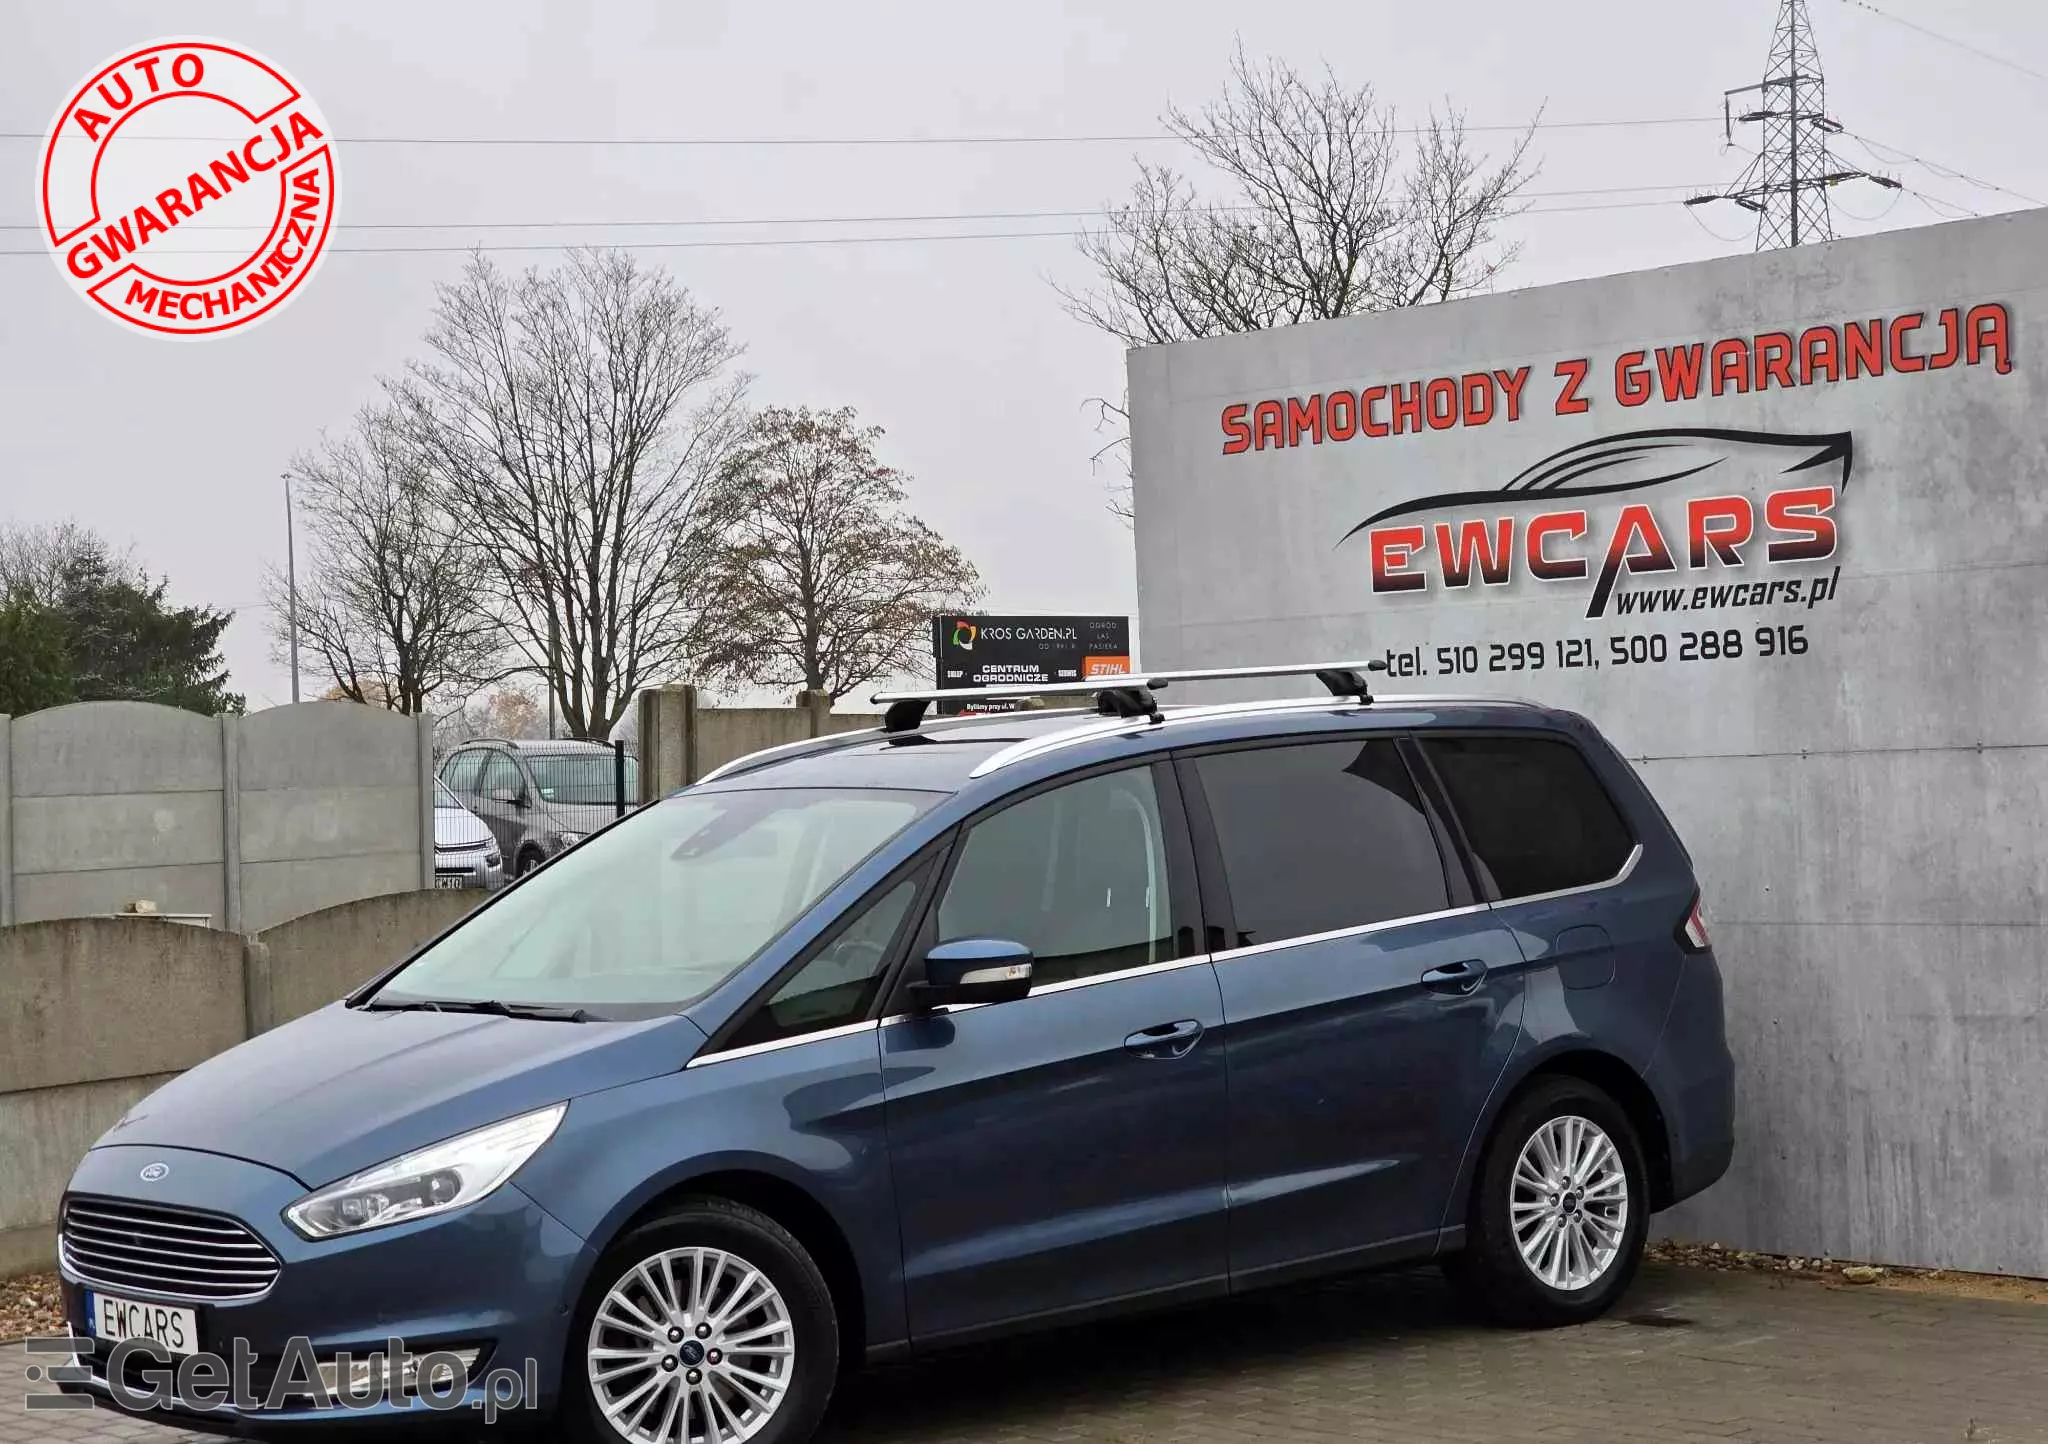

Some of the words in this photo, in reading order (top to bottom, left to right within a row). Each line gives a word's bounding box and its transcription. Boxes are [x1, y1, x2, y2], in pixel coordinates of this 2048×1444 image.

[1222, 365, 1531, 456] SAMOCHODY
[1554, 358, 1589, 416] Z
[1615, 302, 2013, 407] GWARANCJĄ
[1369, 485, 1841, 619] EWCARS
[1616, 566, 1840, 616] www.ewcars.pl
[980, 627, 1012, 640] KROS
[1016, 627, 1078, 640] GARDEN.PL
[1386, 647, 1427, 679] tel.
[1437, 646, 1478, 676] 510
[1489, 642, 1545, 672] 299
[1556, 638, 1600, 670] 121,
[1610, 634, 1668, 665] 500
[1679, 629, 1743, 661] 288
[1755, 624, 1809, 656] 916
[973, 673, 1049, 682] OGRODNICZE
[982, 664, 1040, 673] CENTRUM
[1091, 663, 1126, 674] STIHL
[103, 1299, 184, 1348] EWCARS
